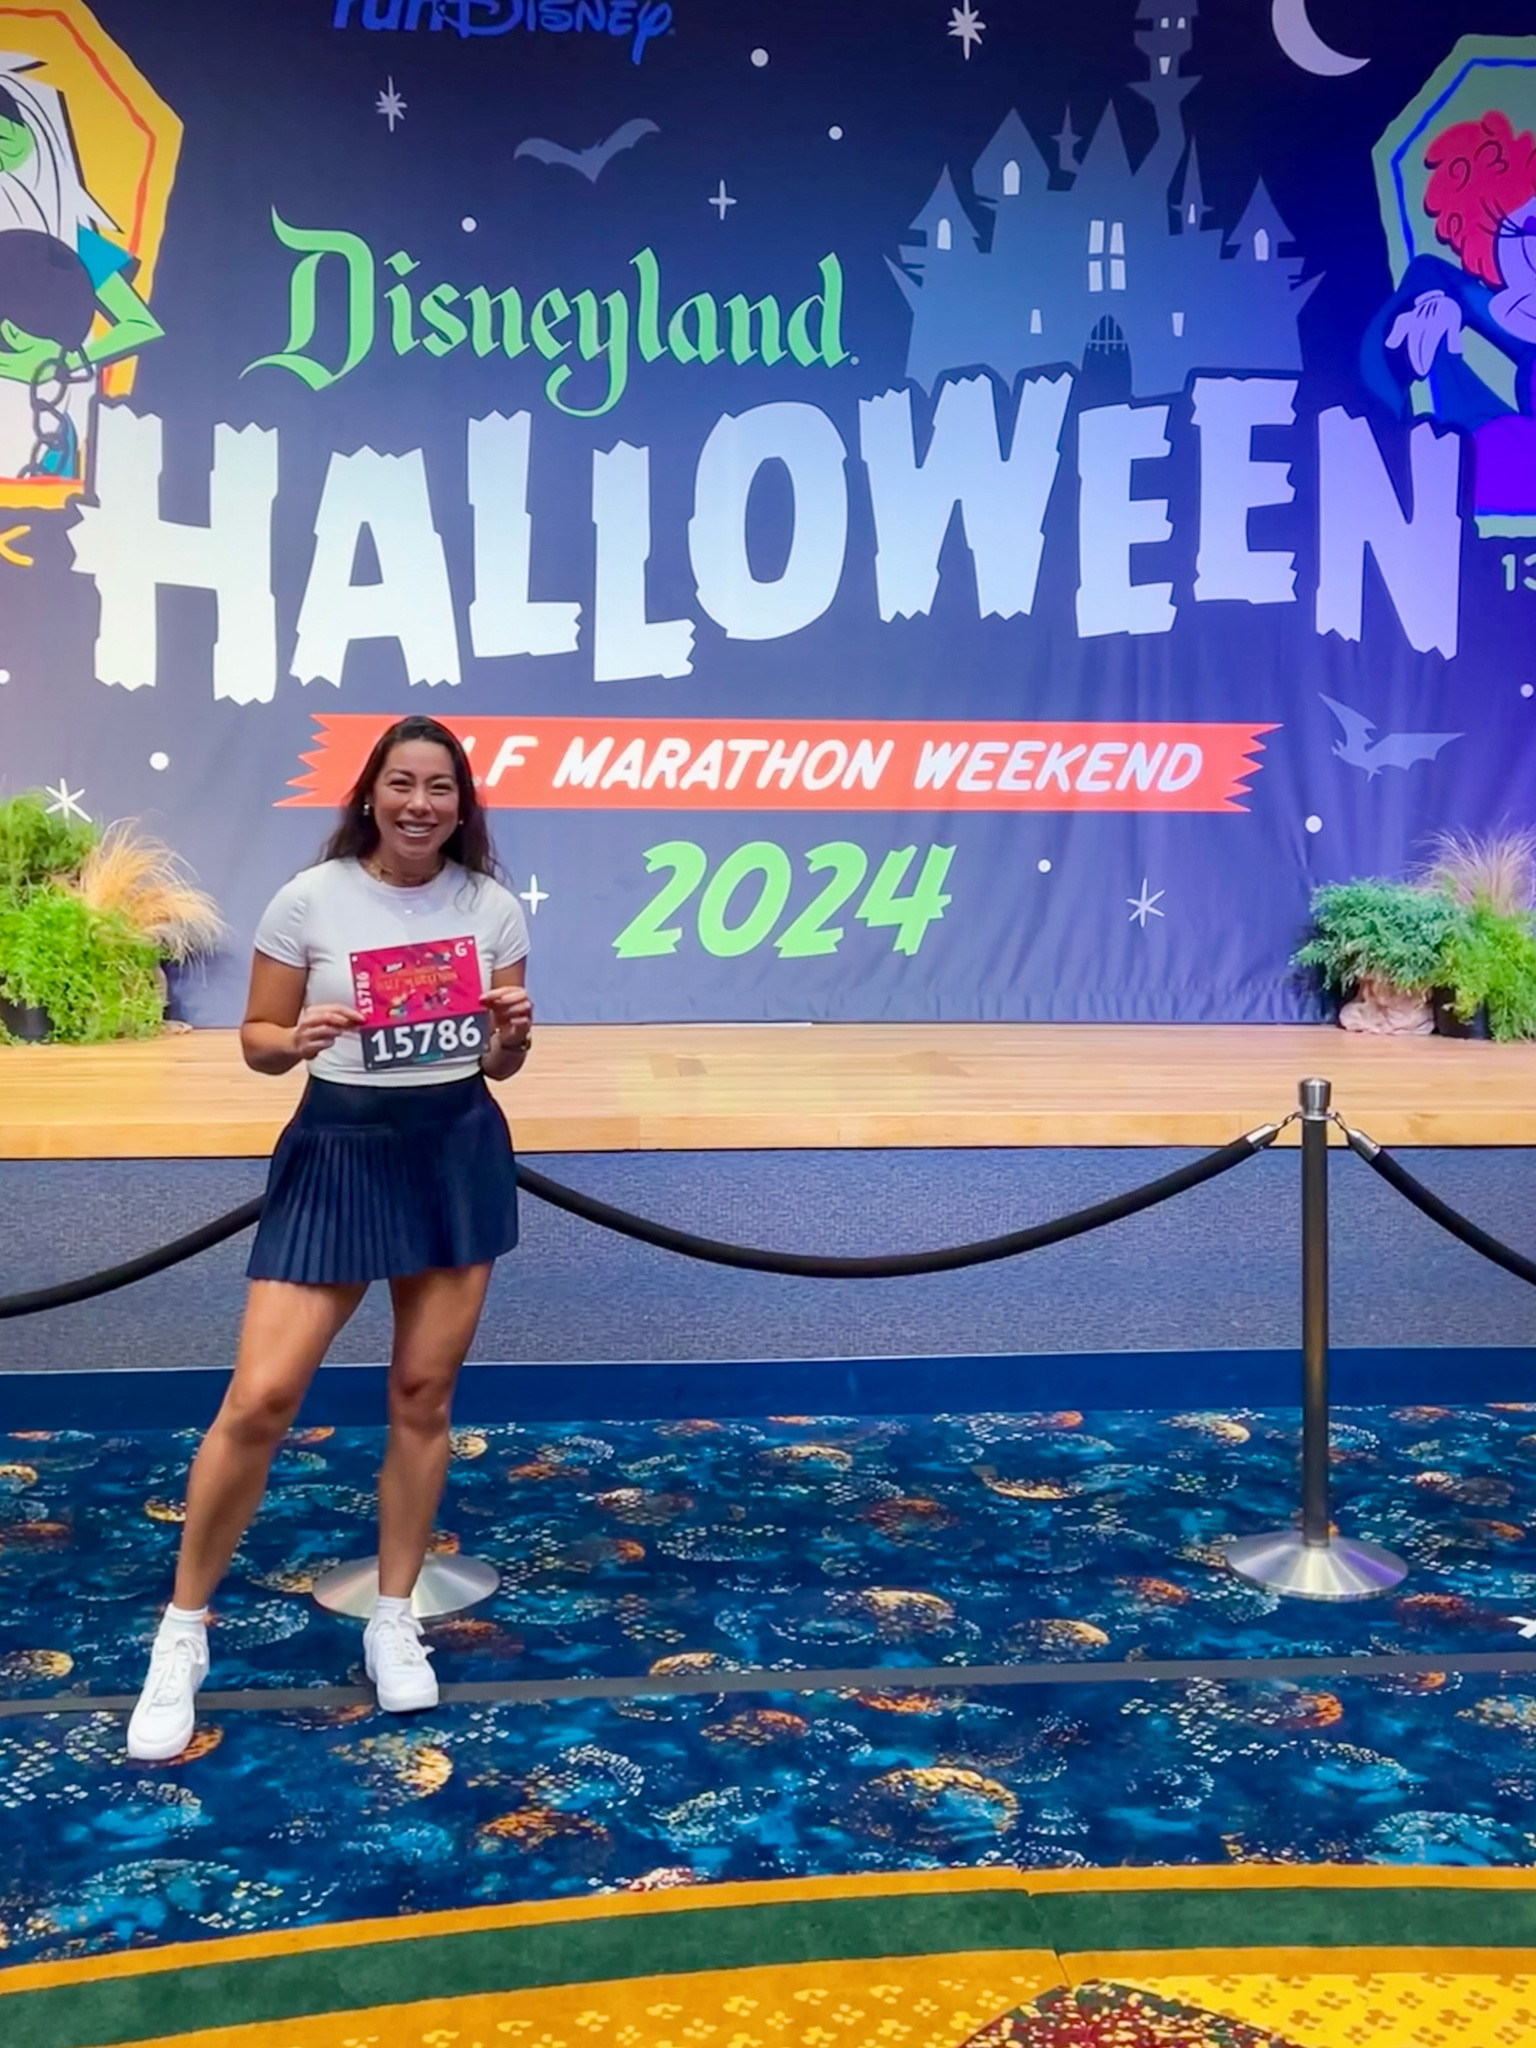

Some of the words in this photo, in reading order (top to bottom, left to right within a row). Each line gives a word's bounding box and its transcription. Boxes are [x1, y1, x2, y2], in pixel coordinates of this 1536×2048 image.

[239, 204, 850, 417] Disneyland
[66, 372, 1462, 705] HALLOWEEN
[552, 736, 895, 791] MARATHON
[914, 740, 1203, 793] WEEKEND
[611, 840, 957, 958] 2024
[454, 942, 468, 958] G
[370, 1016, 481, 1062] 15786
